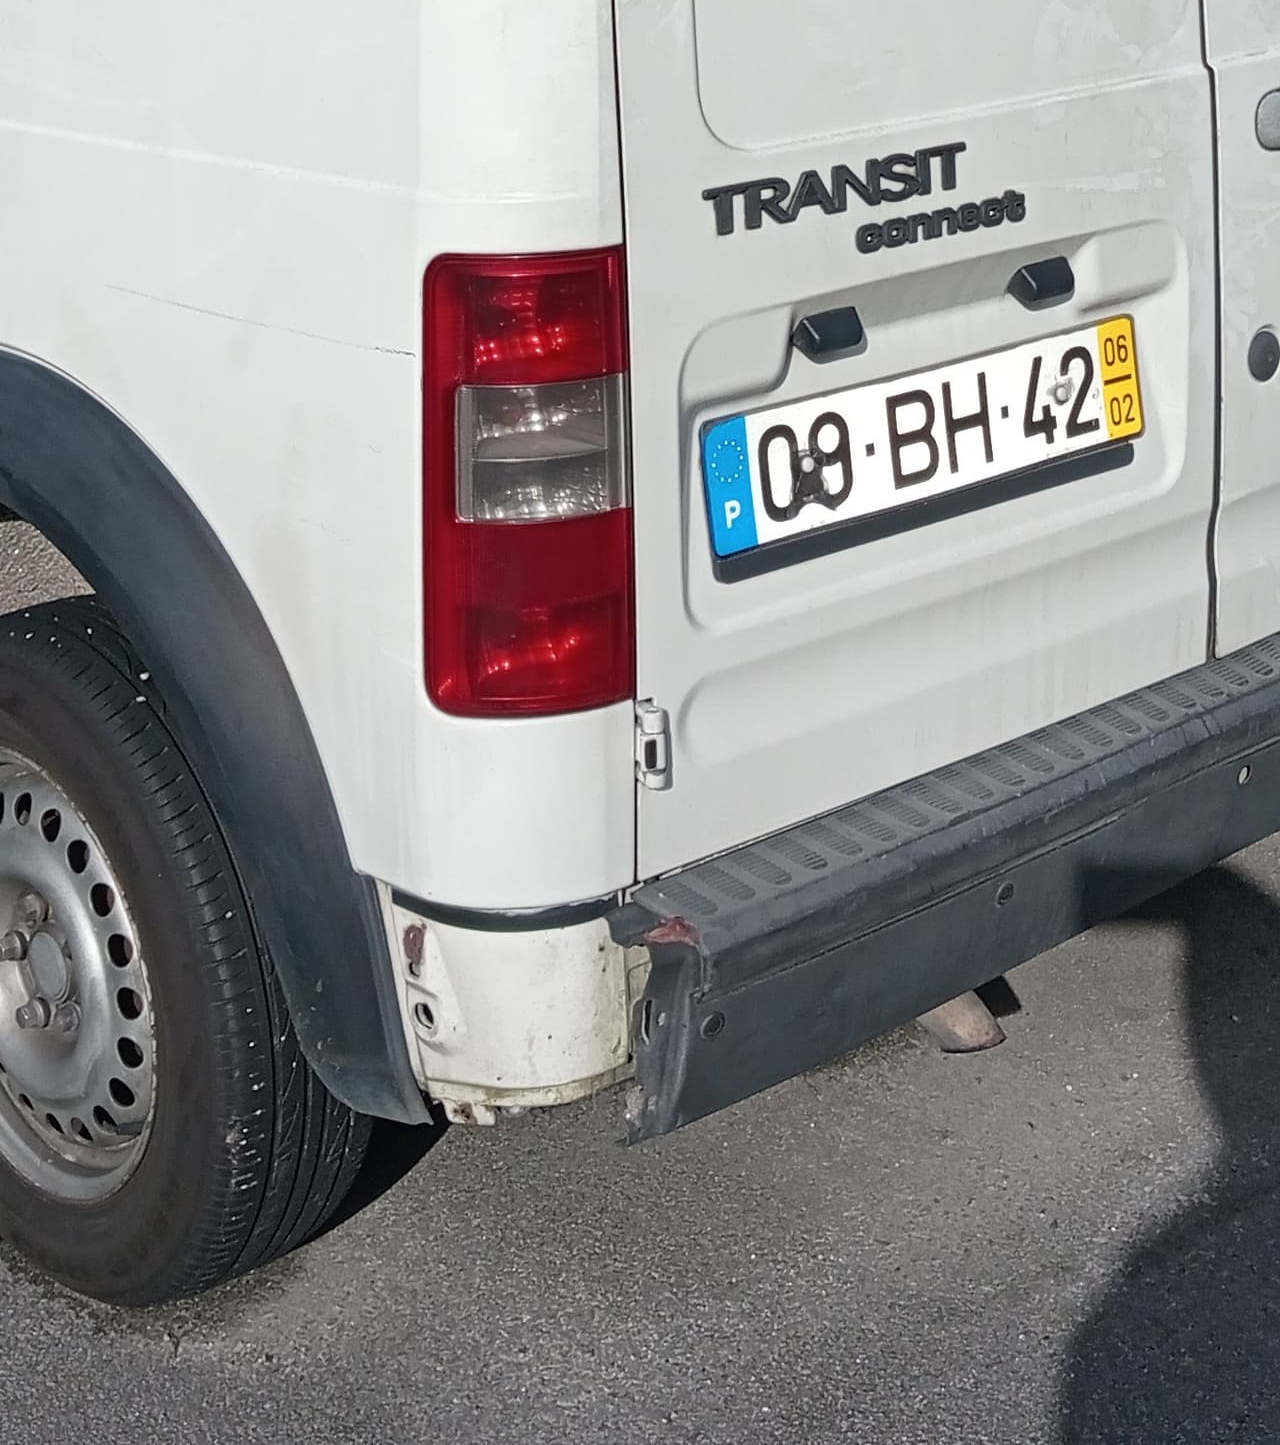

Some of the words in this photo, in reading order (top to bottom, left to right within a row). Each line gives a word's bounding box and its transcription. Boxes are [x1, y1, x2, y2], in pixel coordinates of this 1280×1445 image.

[702, 142, 966, 236] TRANSIT
[856, 189, 1026, 254] connect
[1104, 334, 1129, 367] 06
[1110, 393, 1136, 427] 02
[724, 500, 741, 529] P
